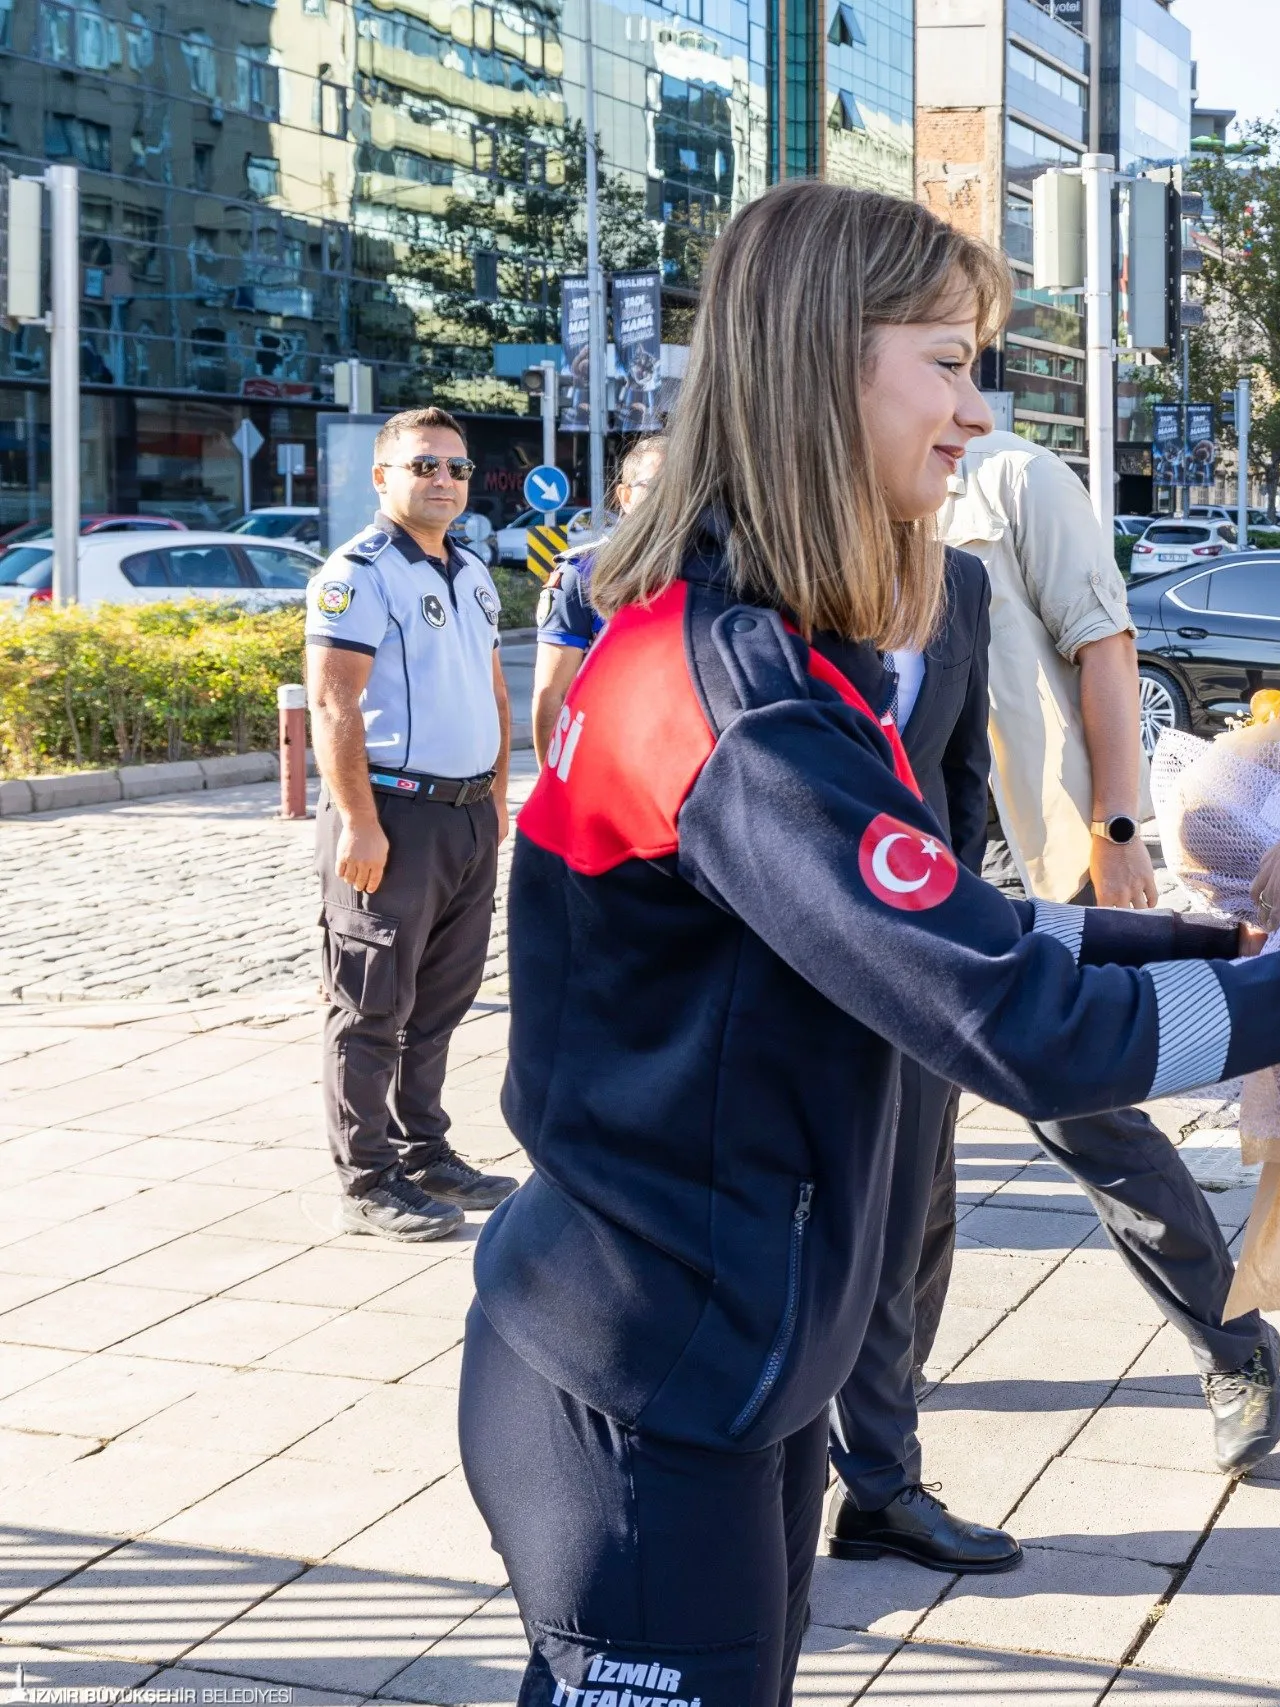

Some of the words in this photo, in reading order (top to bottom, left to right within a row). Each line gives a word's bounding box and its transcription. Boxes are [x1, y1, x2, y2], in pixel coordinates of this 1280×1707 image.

[571, 297, 590, 310] TAD
[620, 315, 654, 334] MAMA
[587, 1653, 682, 1693] İZMİR
[551, 1677, 702, 1707] İTFAİY
